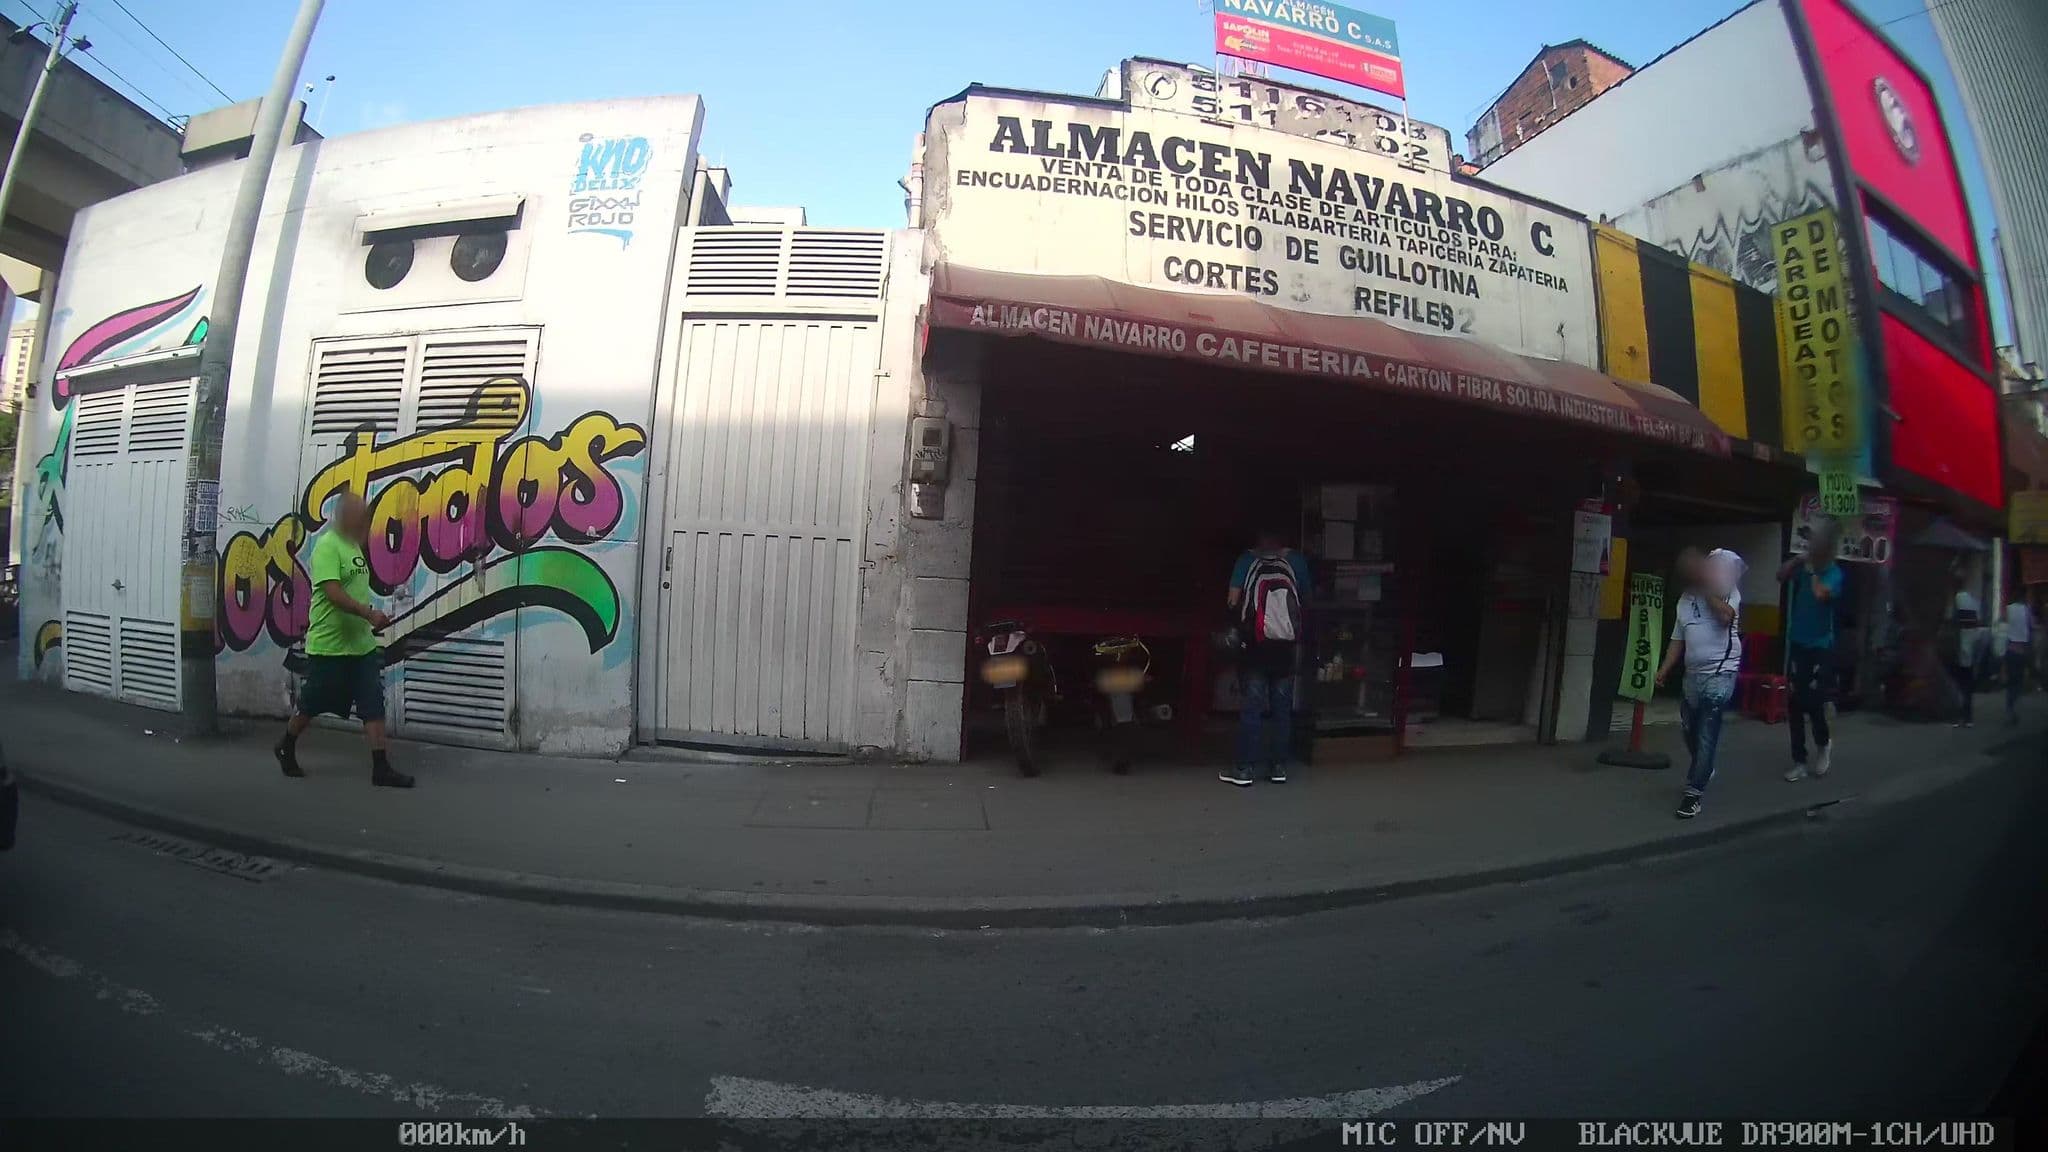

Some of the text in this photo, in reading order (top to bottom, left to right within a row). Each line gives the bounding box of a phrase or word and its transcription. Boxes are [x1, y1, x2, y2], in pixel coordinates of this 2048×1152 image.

[1347, 22, 1361, 40] C
[989, 116, 1272, 188] ALMACEN
[1288, 158, 1504, 242] NAVARRO
[1040, 157, 1517, 262] VENTA DE TODA CLASE DE ARTICULOS PARA:
[956, 170, 1569, 294] ENCUADERNACION HILOS TALABARTERIA TAPICERIA ZAPATERIA
[1129, 210, 1263, 251] SERVICIO
[1286, 236, 1319, 265] DE
[1339, 245, 1480, 299] GUILLOTINA
[1807, 220, 1831, 275] DE
[1163, 256, 1279, 297] CORTES
[1354, 286, 1456, 332] REFILES
[1780, 226, 1822, 442] PARQUEADRO
[969, 304, 1078, 337] ALMACEN
[1083, 315, 1187, 353] NAVARRO
[1196, 332, 1373, 379] CAFETERIA
[1384, 362, 1451, 393] CARTON
[1457, 374, 1502, 403] FIBRA
[1506, 384, 1557, 414] SOLIDA
[1560, 396, 1633, 432] INDUSTRIAL
